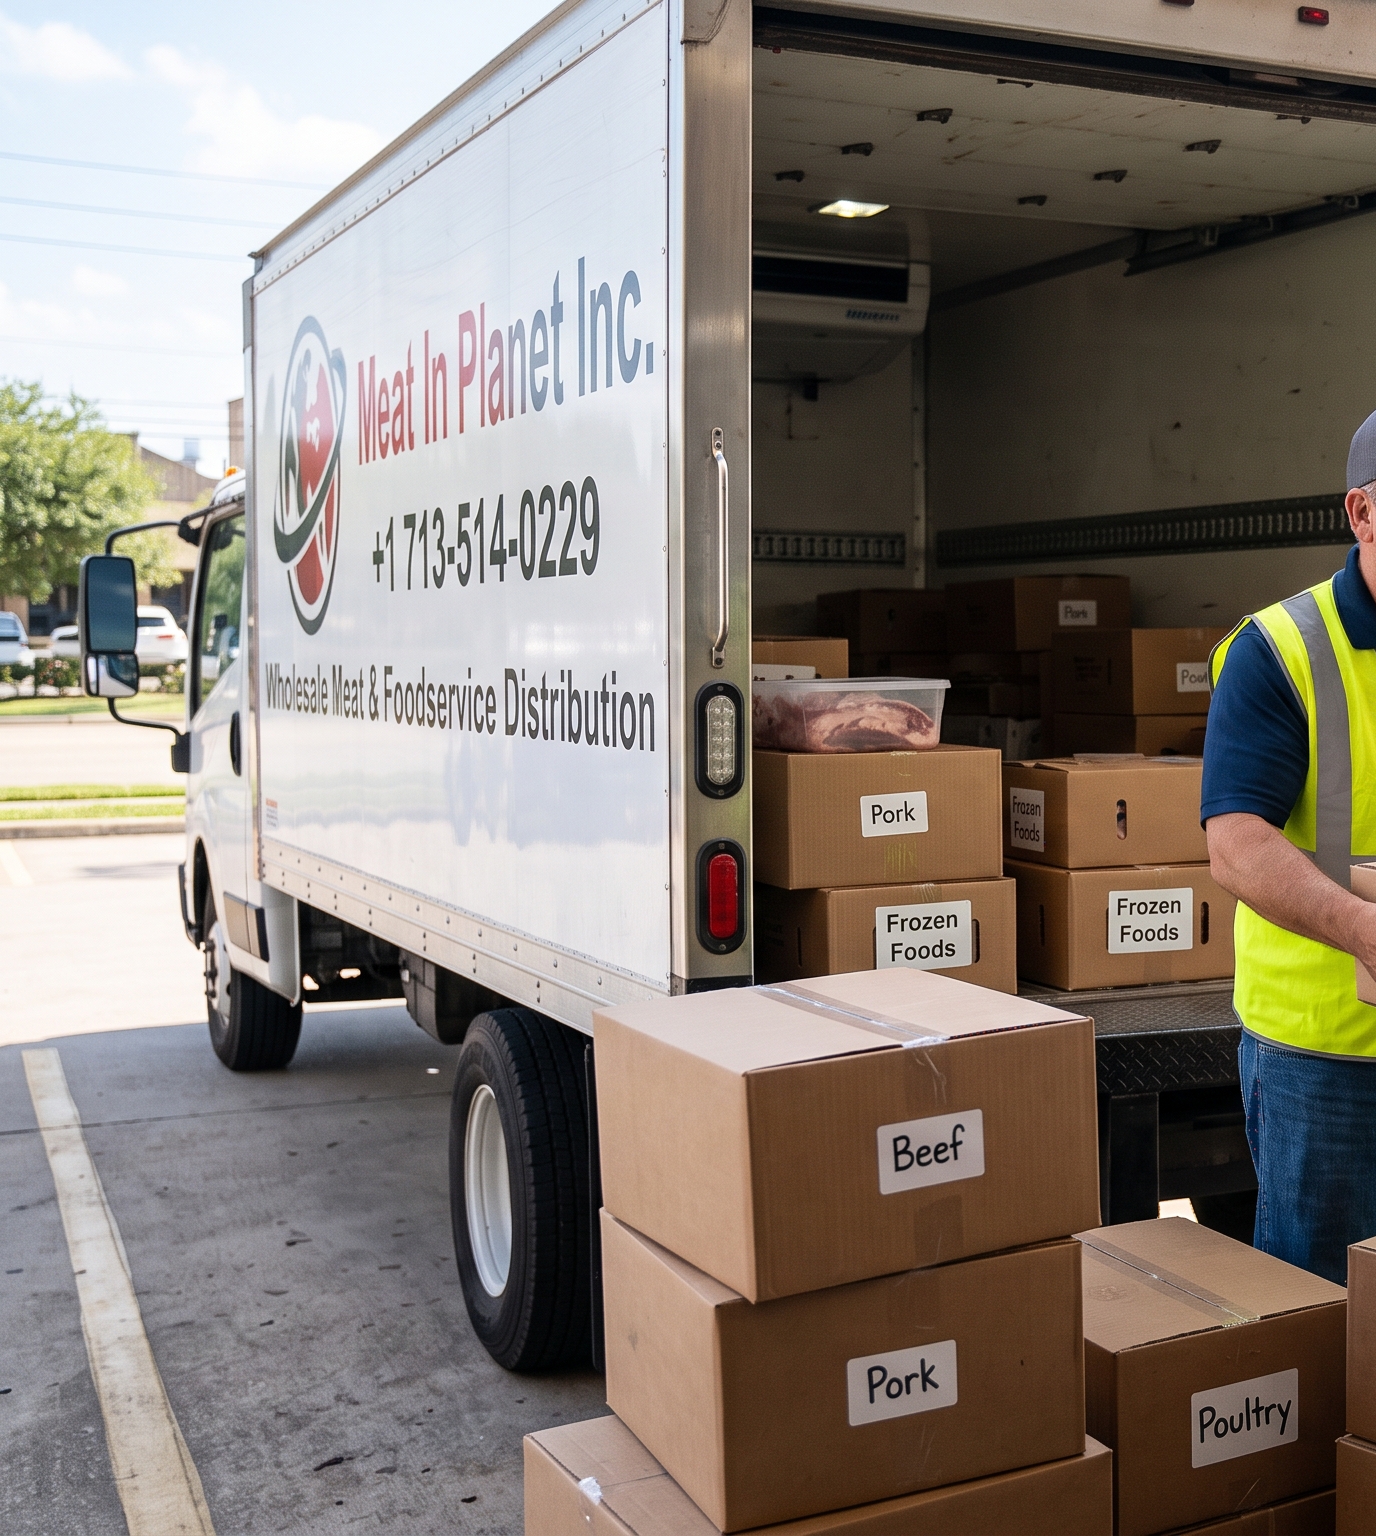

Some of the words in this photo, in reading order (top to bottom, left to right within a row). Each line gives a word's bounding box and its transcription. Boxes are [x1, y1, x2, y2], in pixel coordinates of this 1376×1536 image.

[357, 339, 415, 466] Meat
[423, 328, 448, 446] In
[458, 269, 564, 435] Planet
[577, 256, 655, 398] Inc.
[372, 516, 396, 592] +1
[403, 475, 601, 591] 713-514-0229
[265, 663, 329, 718] Wholesale
[332, 664, 364, 720] Meat
[368, 664, 380, 722] &
[384, 665, 497, 735] Foodservice
[504, 667, 656, 752] Distribution
[871, 801, 916, 825] Pork
[1014, 821, 1040, 842] Foods
[887, 914, 958, 933] Frozen
[1117, 898, 1181, 916] Frozen
[891, 939, 956, 962] Foods
[1120, 923, 1179, 943] Foods
[891, 1123, 966, 1172] Beef
[867, 1357, 940, 1404] Pork
[1199, 1396, 1292, 1443] Poultry
